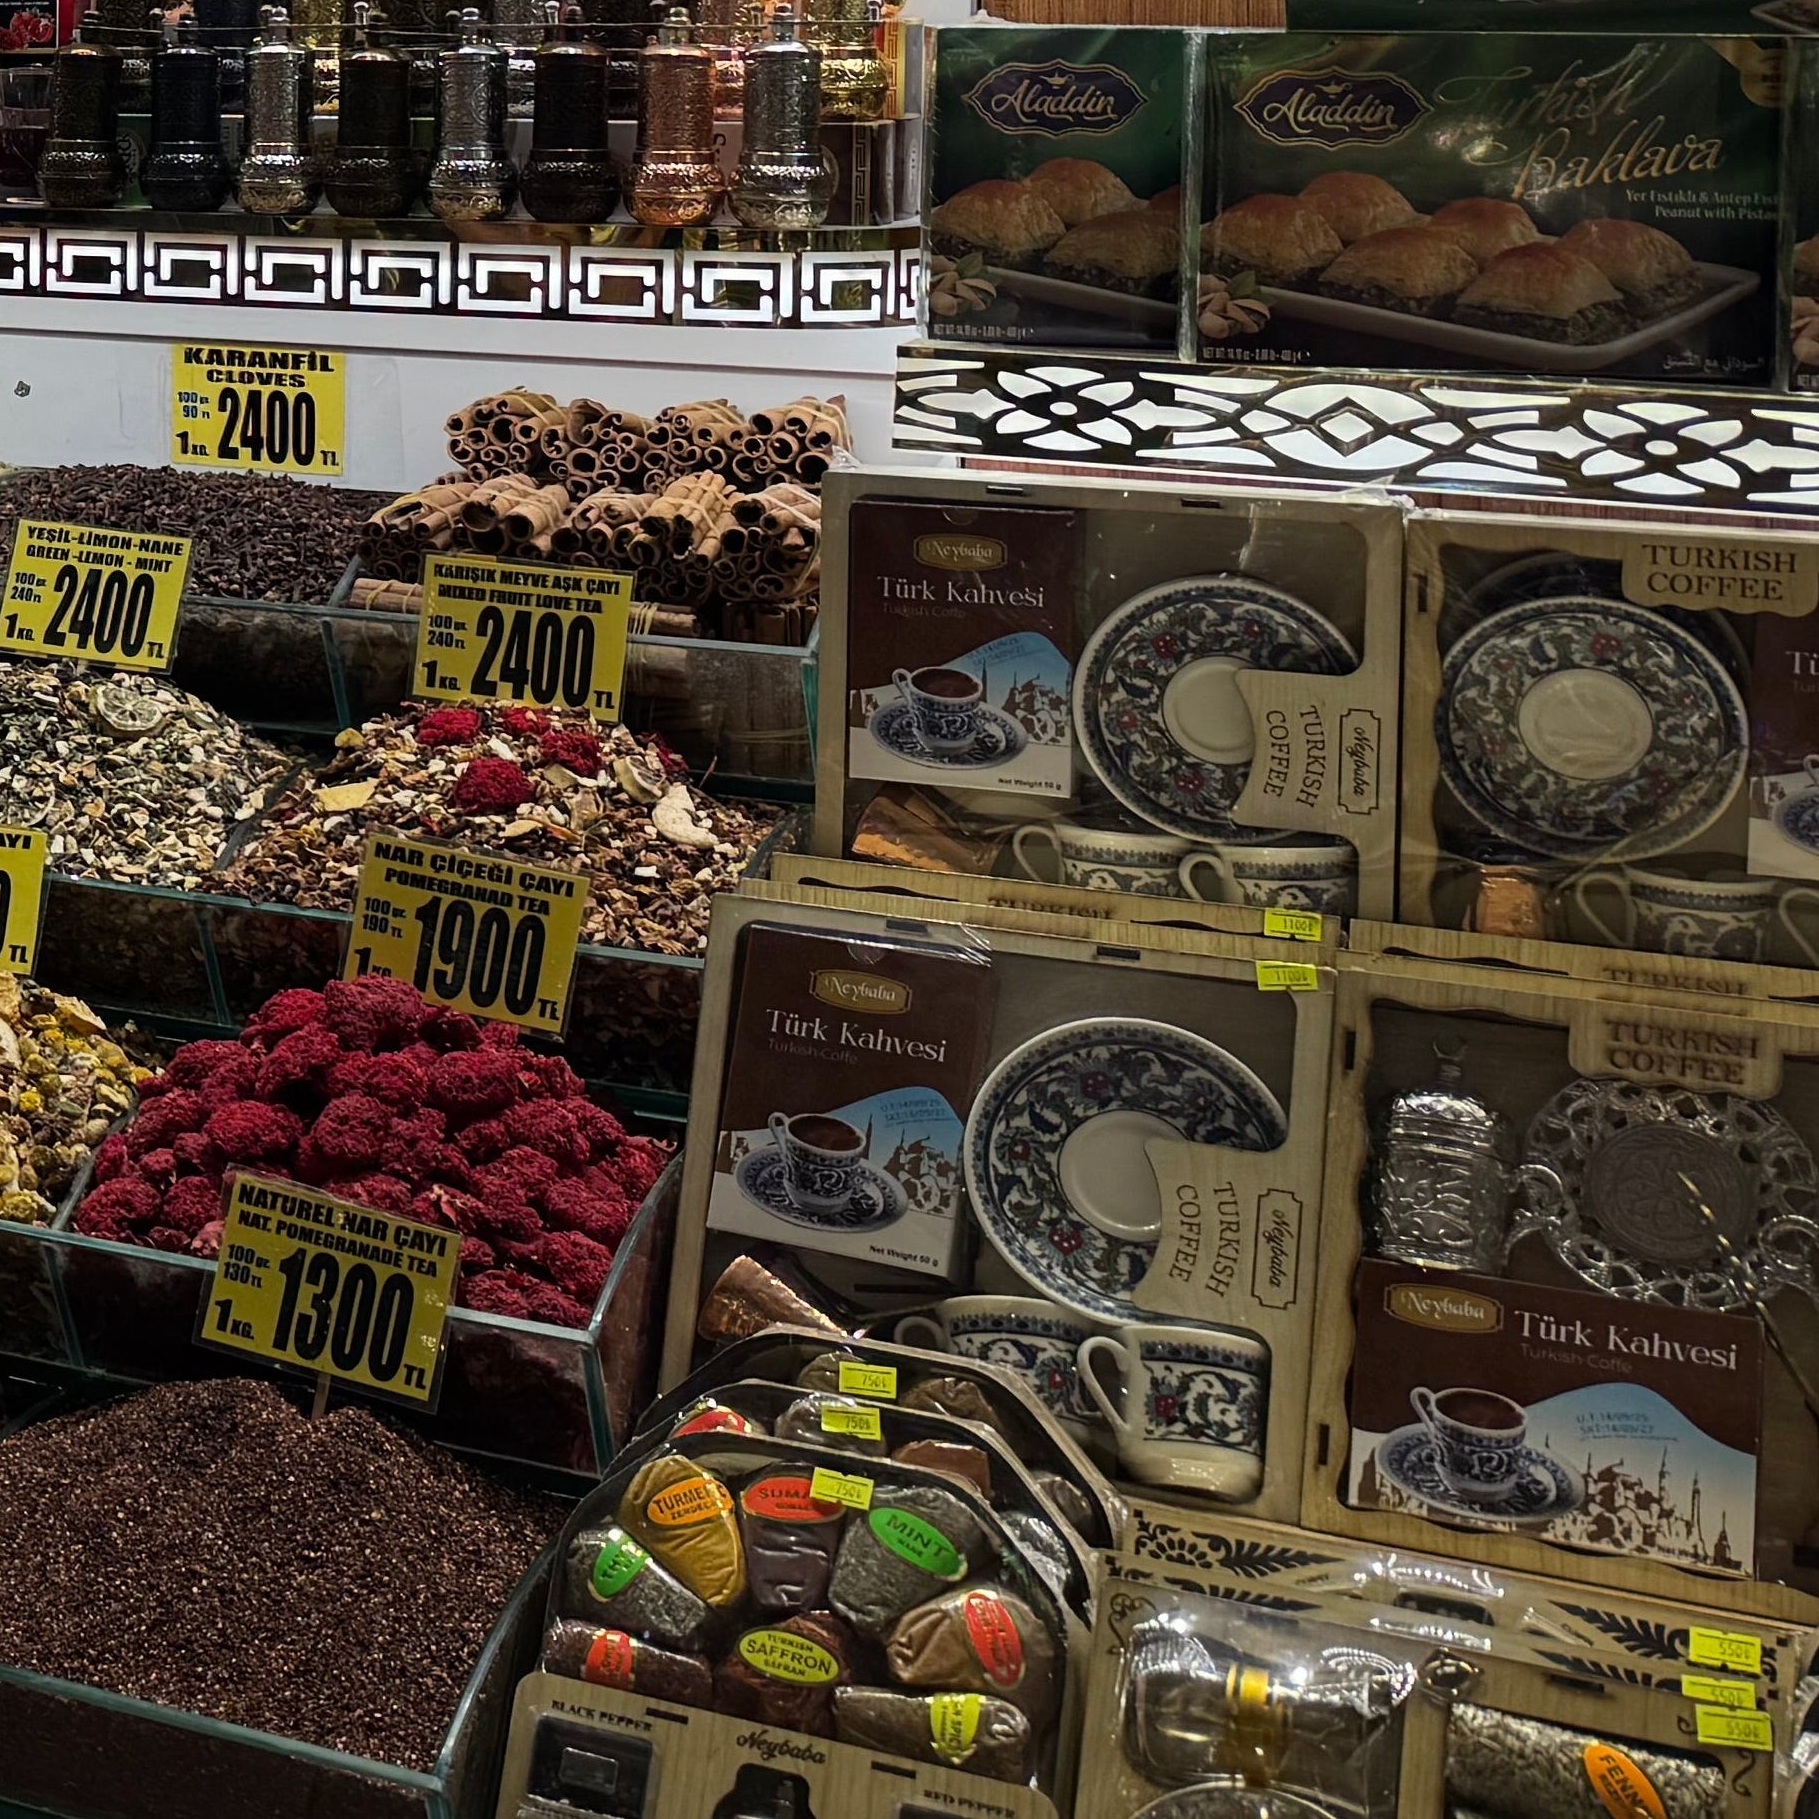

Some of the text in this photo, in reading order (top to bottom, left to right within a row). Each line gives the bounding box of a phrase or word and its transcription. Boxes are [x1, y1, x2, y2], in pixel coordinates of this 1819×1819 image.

[991, 78, 1118, 121] Aladdin
[1262, 80, 1397, 131] Aladdin
[1464, 115, 1723, 200] Baklava
[1655, 205, 1734, 219] Peanut with
[184, 347, 335, 372] KARANFİL
[206, 369, 306, 388] CLOVES
[218, 387, 316, 466] 2400
[26, 545, 173, 573] GREEN MINT
[927, 540, 995, 562] Neybaba
[1642, 544, 1797, 574] TURKISH
[434, 564, 620, 596] KARIŞIK MEYVE AŞK ÇAYI
[438, 584, 603, 614] MIXED LOVE TEA
[877, 575, 1045, 608] Türk Kahvesi
[1647, 572, 1785, 601] COFFEE
[43, 564, 155, 657] 2400
[470, 605, 595, 708] 2400
[1262, 709, 1287, 798] COFFEE
[1296, 705, 1328, 808] TURKISH
[1352, 726, 1370, 800] Neybaba
[374, 841, 575, 898] NAR ÇİÇEĞİ ÇAYI
[384, 867, 550, 916] POMEGRANAD TEA
[413, 895, 546, 1016] 1900
[826, 976, 896, 1002] Neybaba
[766, 1009, 947, 1063] Türk Kahvesi
[769, 1038, 818, 1057] Turkish
[1605, 1019, 1759, 1059] TURKISH
[1609, 1048, 1743, 1085] COFFEE
[237, 1182, 448, 1258] NATUREL NAR ÇAYI
[1169, 1183, 1200, 1285] COFFEE
[275, 1219, 438, 1278] POMEGRANADE TEA
[870, 1245, 917, 1261] Net Weight
[1210, 1182, 1235, 1300] TURKISH
[1269, 1205, 1286, 1292] Neybaba
[223, 1261, 251, 1284] 130
[272, 1247, 414, 1383] 1300
[1401, 1290, 1484, 1321] Neybaba
[1515, 1310, 1738, 1371] Türk Kahvesi
[1520, 1343, 1582, 1366] Turkish
[403, 1363, 427, 1390] TL
[885, 1515, 950, 1559] MINT
[745, 1639, 833, 1677] SAFFRON
[766, 1632, 815, 1653] TURKISH
[551, 1699, 654, 1733] BLACK PEPPER
[737, 1728, 827, 1765] Neybaba
